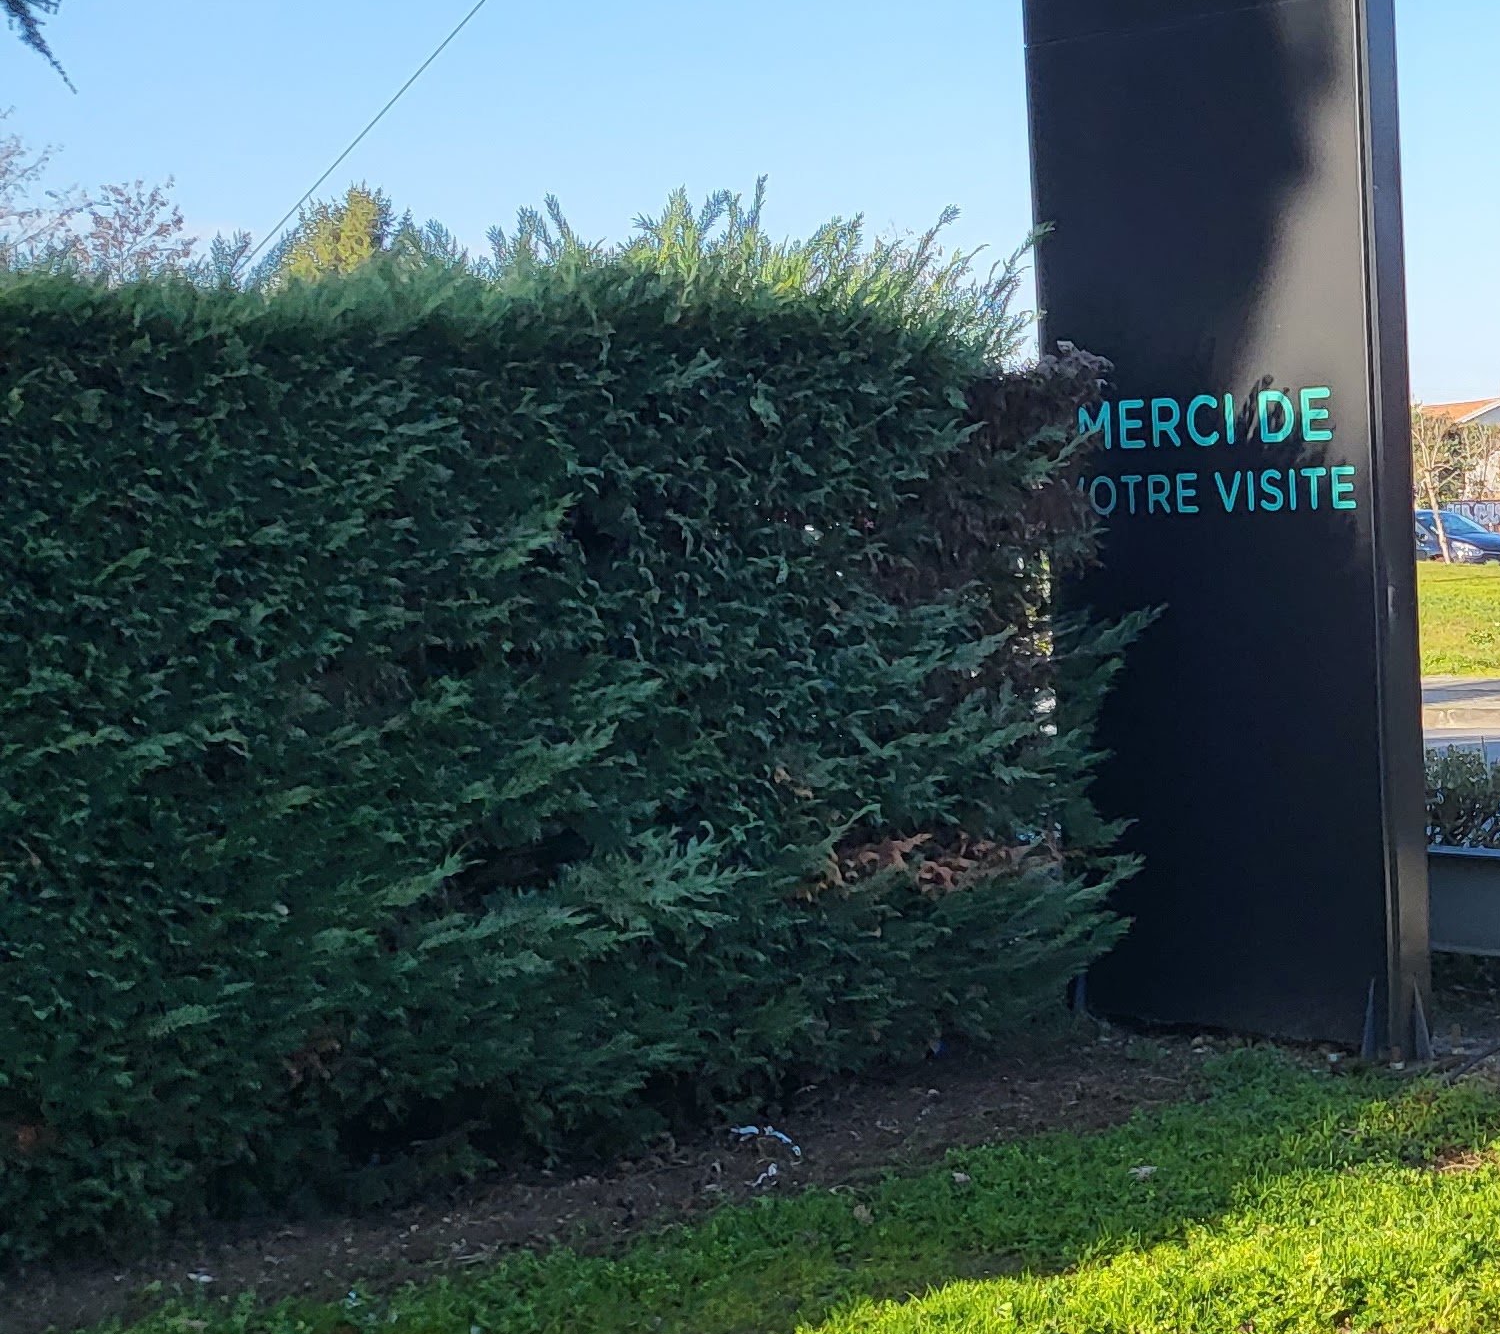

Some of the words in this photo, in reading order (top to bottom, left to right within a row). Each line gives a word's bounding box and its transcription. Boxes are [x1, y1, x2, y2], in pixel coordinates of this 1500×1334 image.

[1078, 393, 1235, 450] MERCI
[1258, 386, 1333, 443] DE
[1078, 472, 1200, 516] OTRE
[1214, 466, 1357, 513] VISITE
